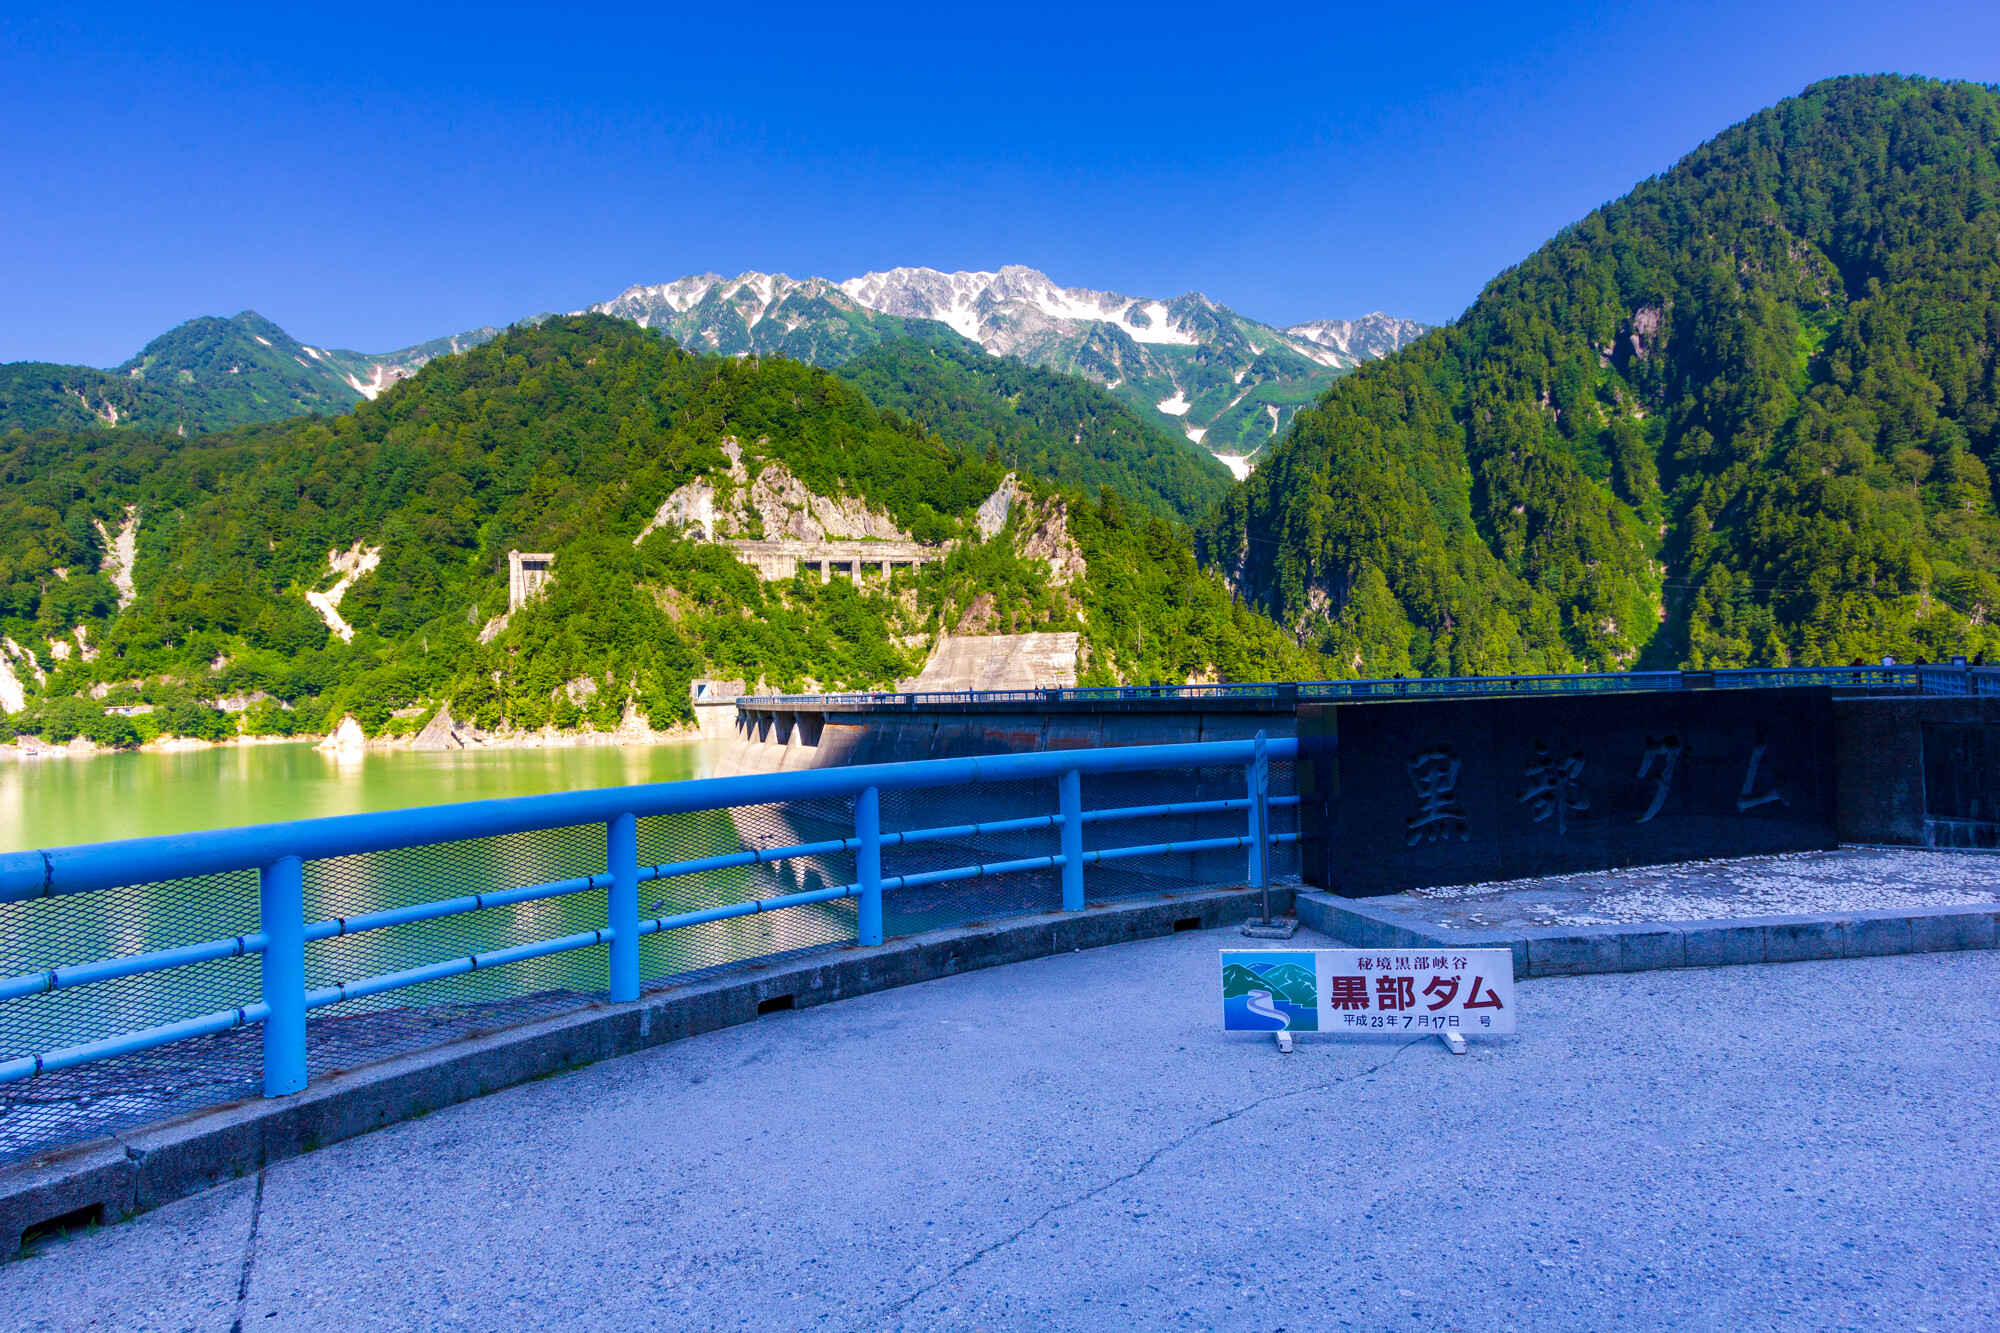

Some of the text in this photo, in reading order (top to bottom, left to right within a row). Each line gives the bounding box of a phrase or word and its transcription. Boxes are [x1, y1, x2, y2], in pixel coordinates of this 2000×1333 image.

[1406, 727, 1790, 847] 黒部ダム
[1357, 956, 1468, 971] 秘境黒部峡谷
[1331, 975, 1504, 1011] 黒部ダム
